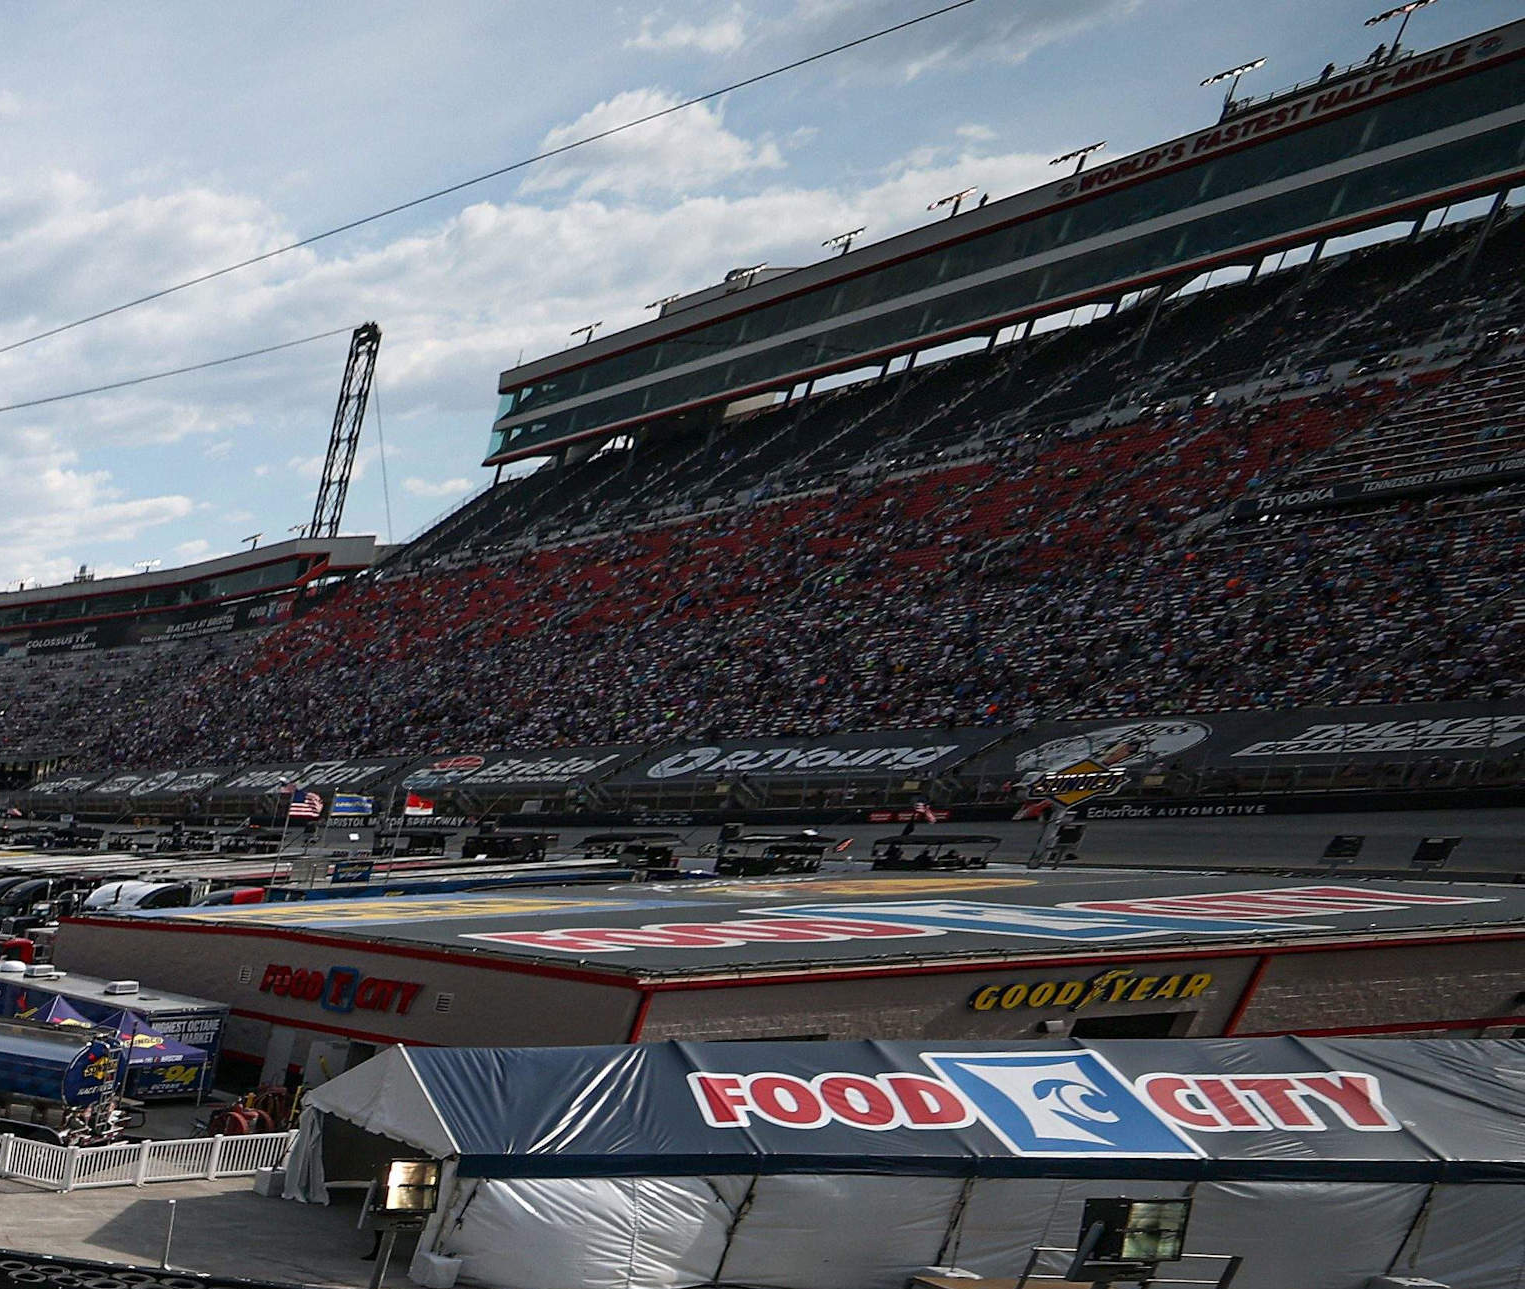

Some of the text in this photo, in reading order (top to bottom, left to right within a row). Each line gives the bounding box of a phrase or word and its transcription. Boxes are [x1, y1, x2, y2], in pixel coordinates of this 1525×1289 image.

[1077, 44, 1471, 193] WORLD'S FASTEST HALF-MILE
[479, 754, 620, 778] Bristol
[1087, 804, 1268, 820] EchoPark AUTOMOTIVE
[258, 963, 427, 1015] FOOD CITY
[970, 970, 1213, 1013] GOODYEAR
[181, 1031, 216, 1044] MARKET
[188, 1019, 220, 1032] OCTANE
[687, 1071, 1402, 1132] FOOD CITY
